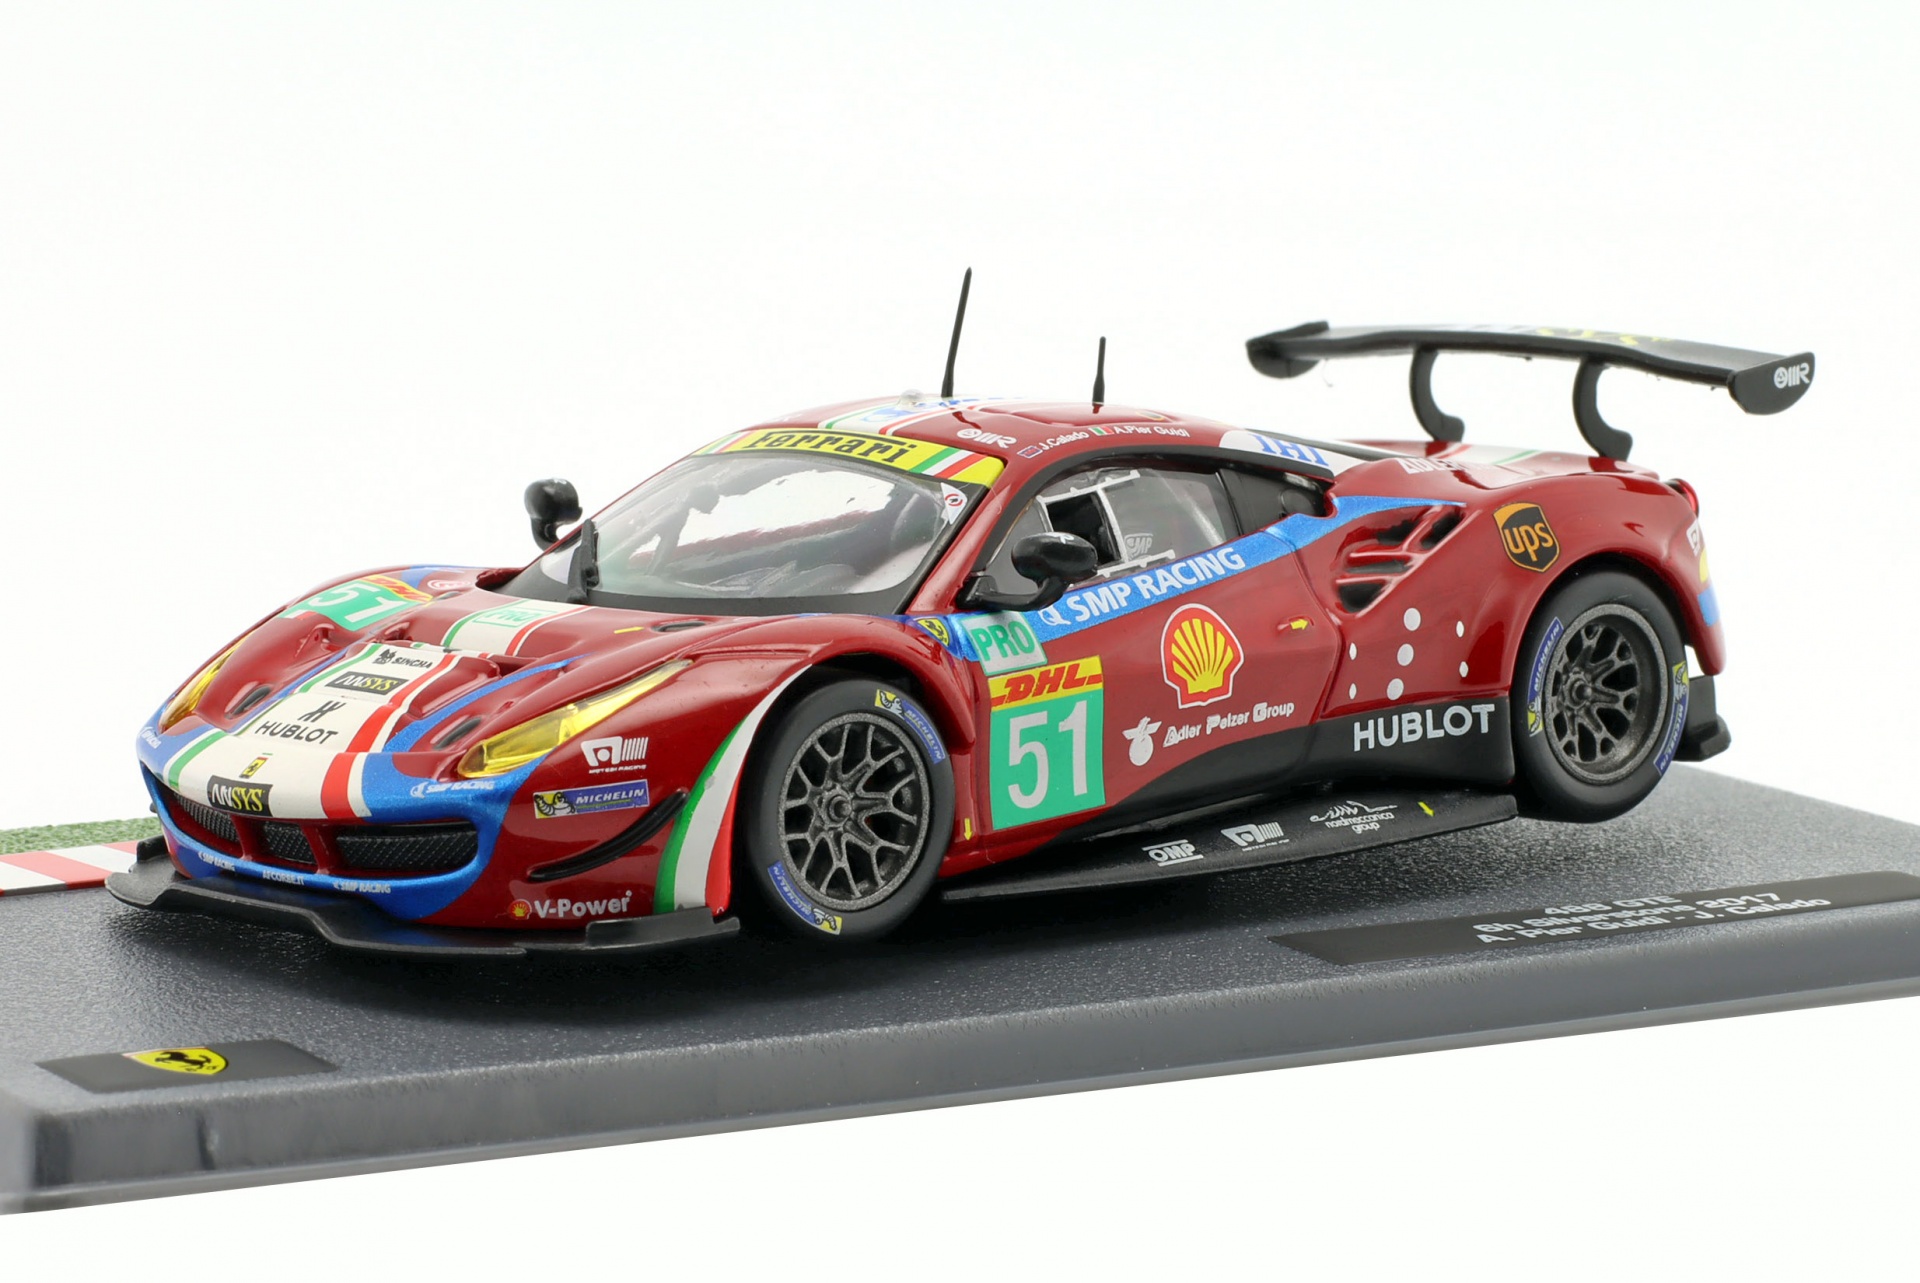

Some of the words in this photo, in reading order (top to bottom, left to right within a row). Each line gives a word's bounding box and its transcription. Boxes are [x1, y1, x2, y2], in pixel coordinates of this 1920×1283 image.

[742, 430, 918, 464] Ferrari
[1154, 426, 1191, 437] Guidi
[1503, 521, 1554, 562] ups
[1066, 580, 1132, 623] SMP
[1131, 547, 1246, 599] RACING
[970, 619, 1037, 662] PRO
[1003, 662, 1088, 704] DHL
[254, 720, 339, 745] HUBLOT
[1163, 724, 1202, 748] Adler
[1206, 711, 1250, 735] Pelzer
[1252, 702, 1295, 723] Group
[1353, 703, 1495, 752] HUBLOT
[1007, 700, 1088, 809] 51
[211, 782, 266, 812] ANSYS
[575, 788, 646, 804] MICHELIN
[1352, 821, 1381, 835] group
[1148, 842, 1197, 864] OMP
[533, 893, 631, 919] V-Power
[1472, 922, 1525, 933] 6h
[1522, 904, 1697, 927] Silverstone
[1695, 892, 1781, 909] 2017
[1476, 933, 1517, 944] A.
[1515, 925, 1584, 939] Pier
[1587, 915, 1671, 931] Guidi
[1694, 910, 1726, 919] J.
[1724, 898, 1832, 915] Calado
[1544, 902, 1613, 915] 488
[1612, 895, 1683, 908] GTE
